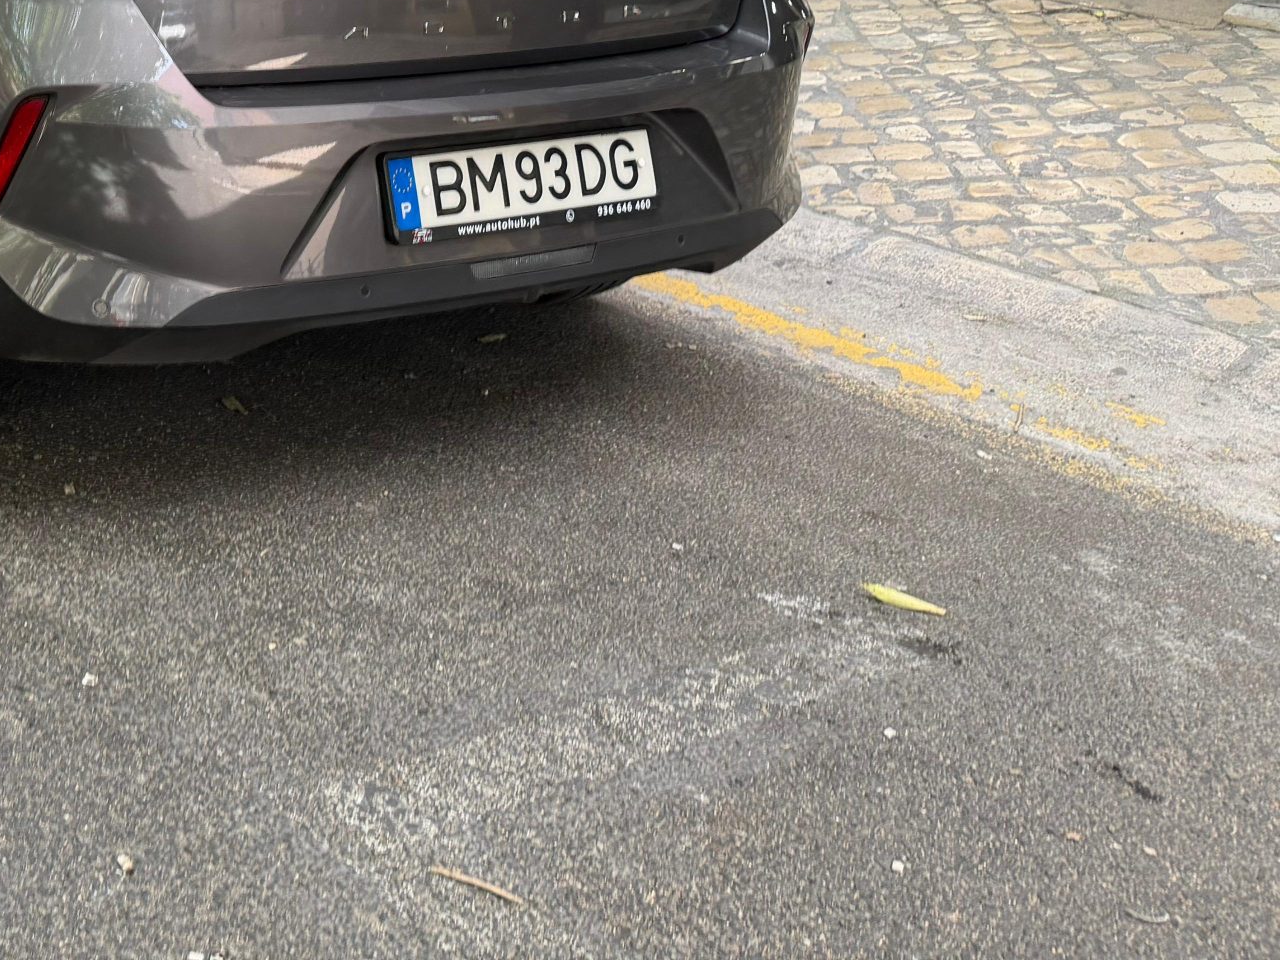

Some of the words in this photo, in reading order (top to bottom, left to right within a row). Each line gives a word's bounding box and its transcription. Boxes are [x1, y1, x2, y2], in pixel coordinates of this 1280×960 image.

[428, 138, 639, 217] BM93DG
[401, 202, 411, 219] P
[458, 216, 540, 236] www.autohub.pt
